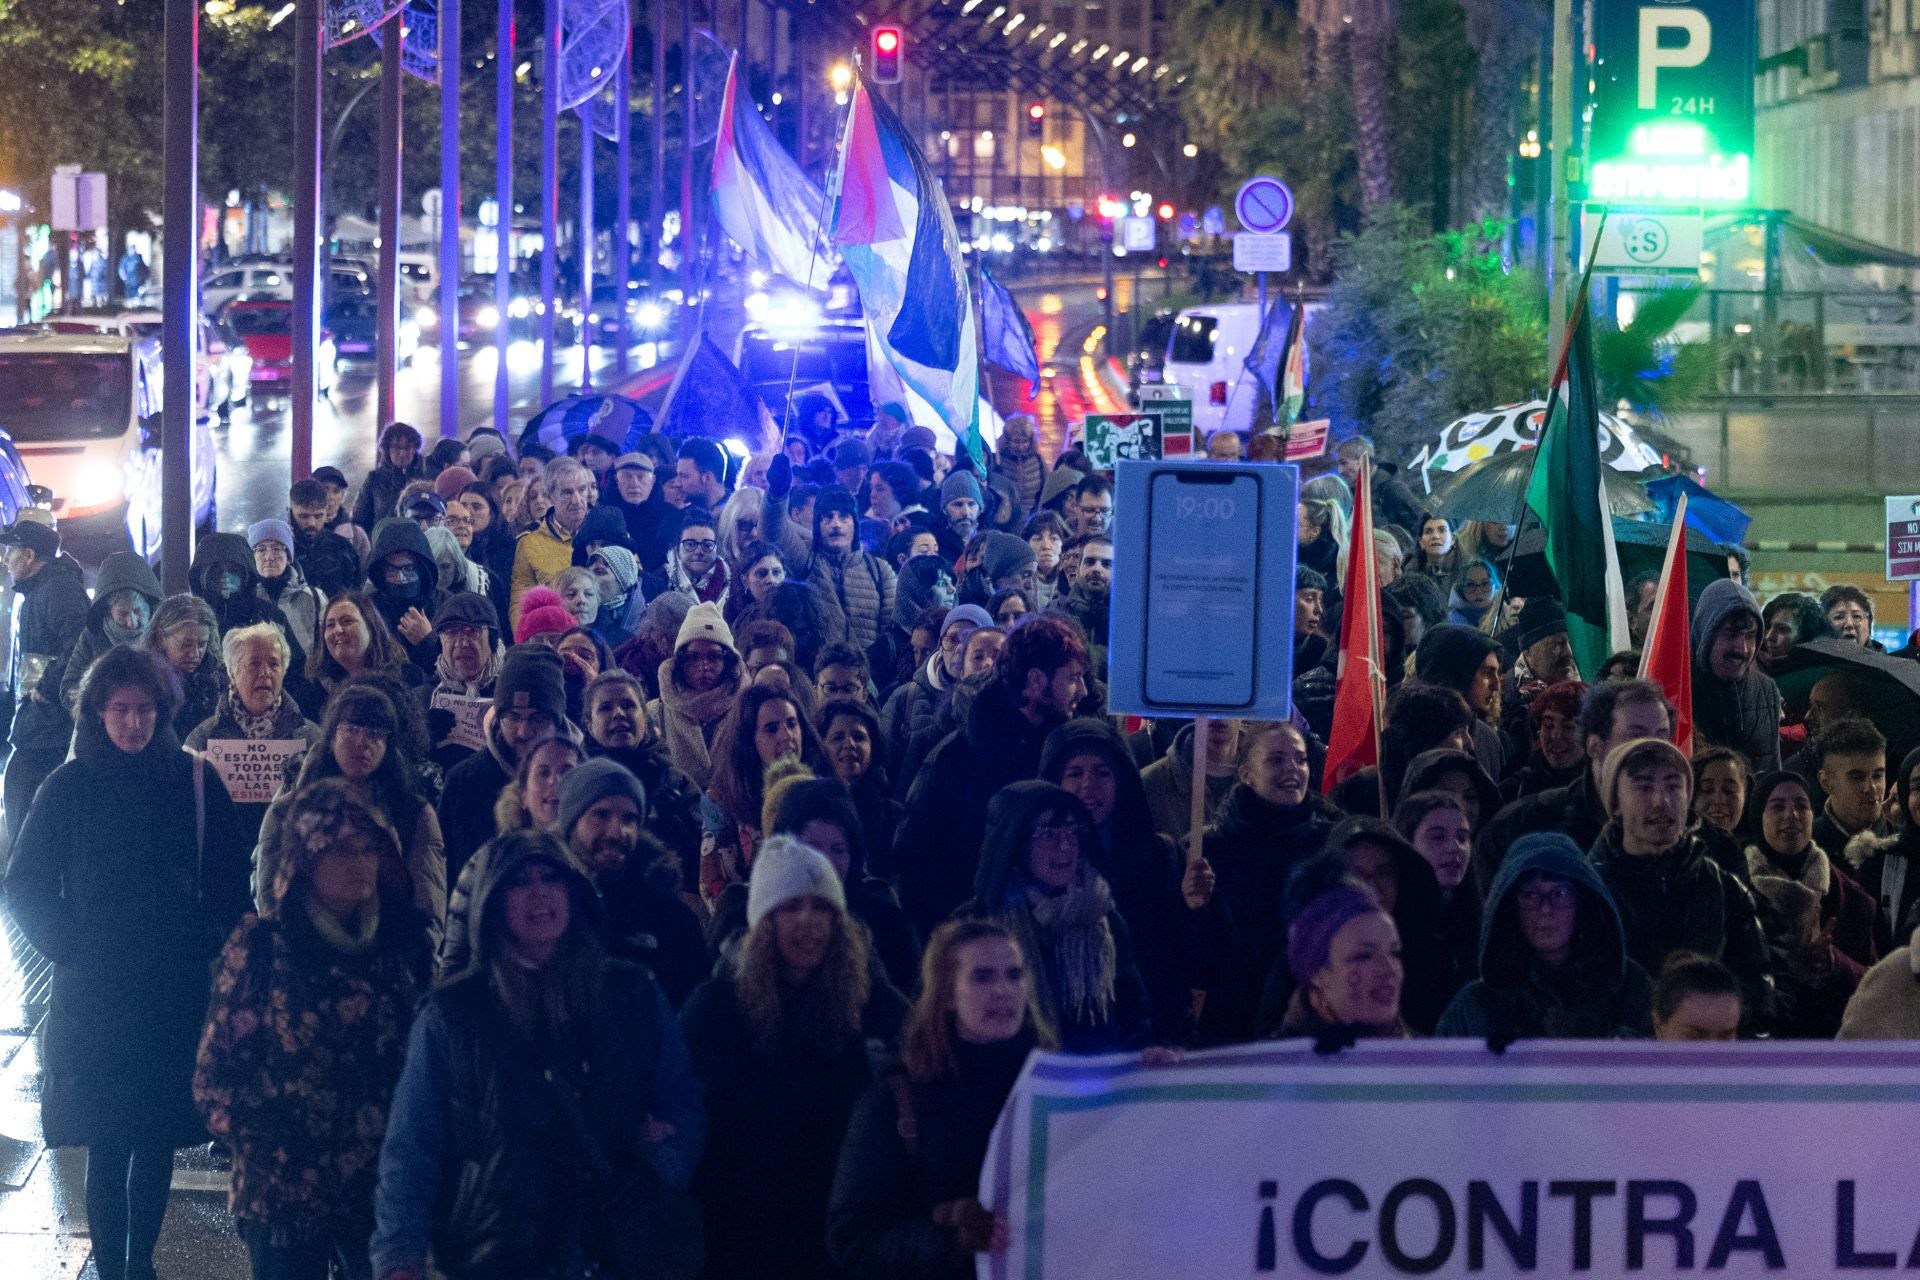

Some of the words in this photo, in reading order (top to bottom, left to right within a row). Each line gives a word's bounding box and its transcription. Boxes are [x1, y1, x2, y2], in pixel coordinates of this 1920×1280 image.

[1638, 8, 1712, 110] P
[1670, 97, 1715, 115] 24H
[1907, 523, 1918, 534] NO
[1897, 541, 1912, 554] SIN
[247, 744, 267, 752] NO
[224, 753, 290, 762] ESTAMOS
[233, 763, 281, 772] TODAS
[227, 773, 282, 781] FALTAN
[244, 782, 270, 790] LAS
[231, 791, 273, 799] ESINA
[1255, 1177, 1788, 1275] ¡CONTRA
[1834, 1178, 1920, 1272] L
